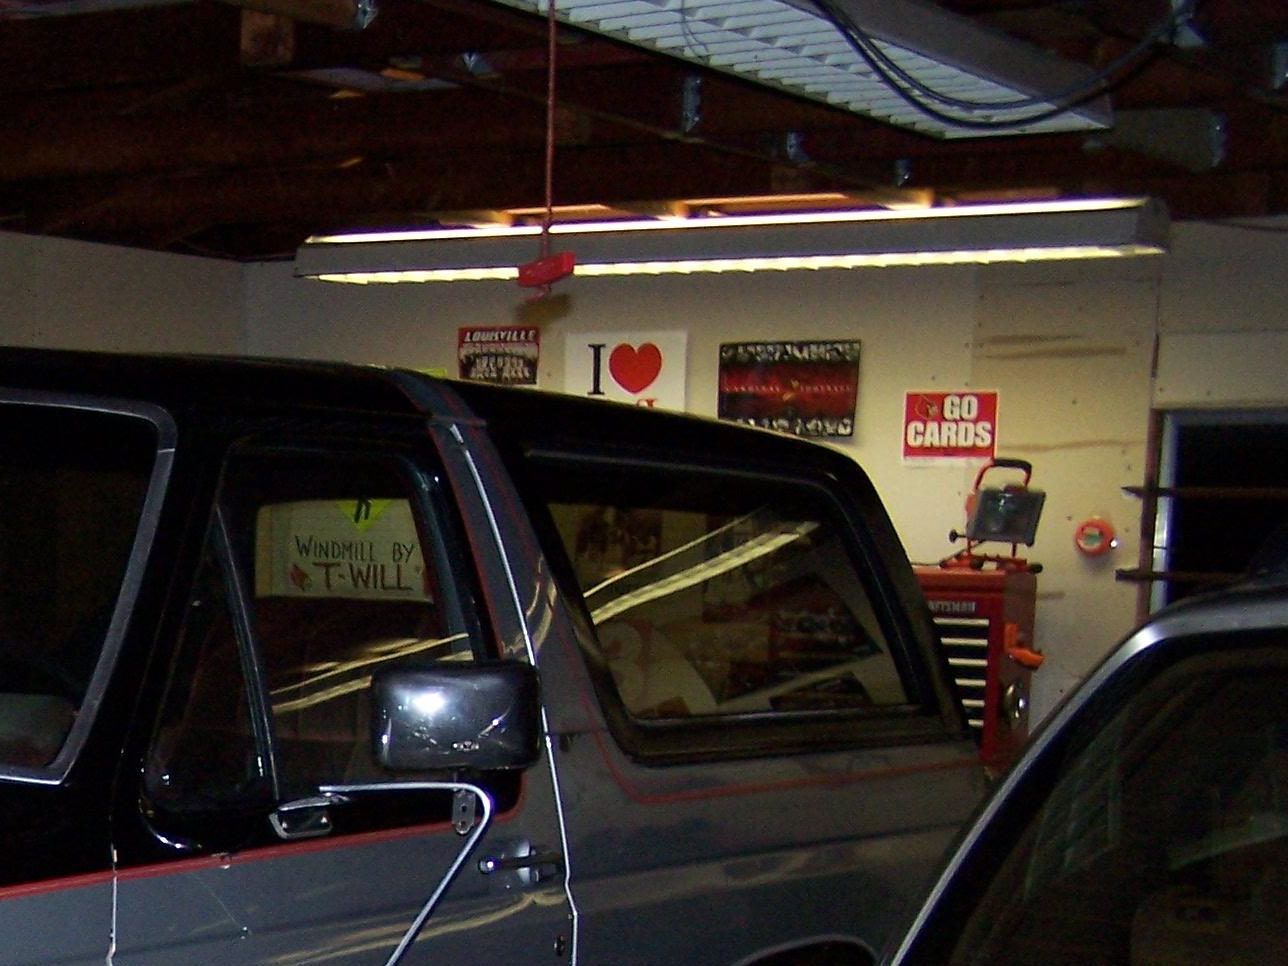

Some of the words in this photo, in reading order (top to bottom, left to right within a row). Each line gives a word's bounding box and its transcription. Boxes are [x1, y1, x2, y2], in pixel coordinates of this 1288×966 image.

[464, 329, 536, 342] LOUISVILLE
[587, 343, 607, 395] I
[943, 395, 978, 420] GO
[907, 421, 992, 448] CARDS
[294, 534, 376, 562] WINDMILL
[392, 543, 414, 563] BY
